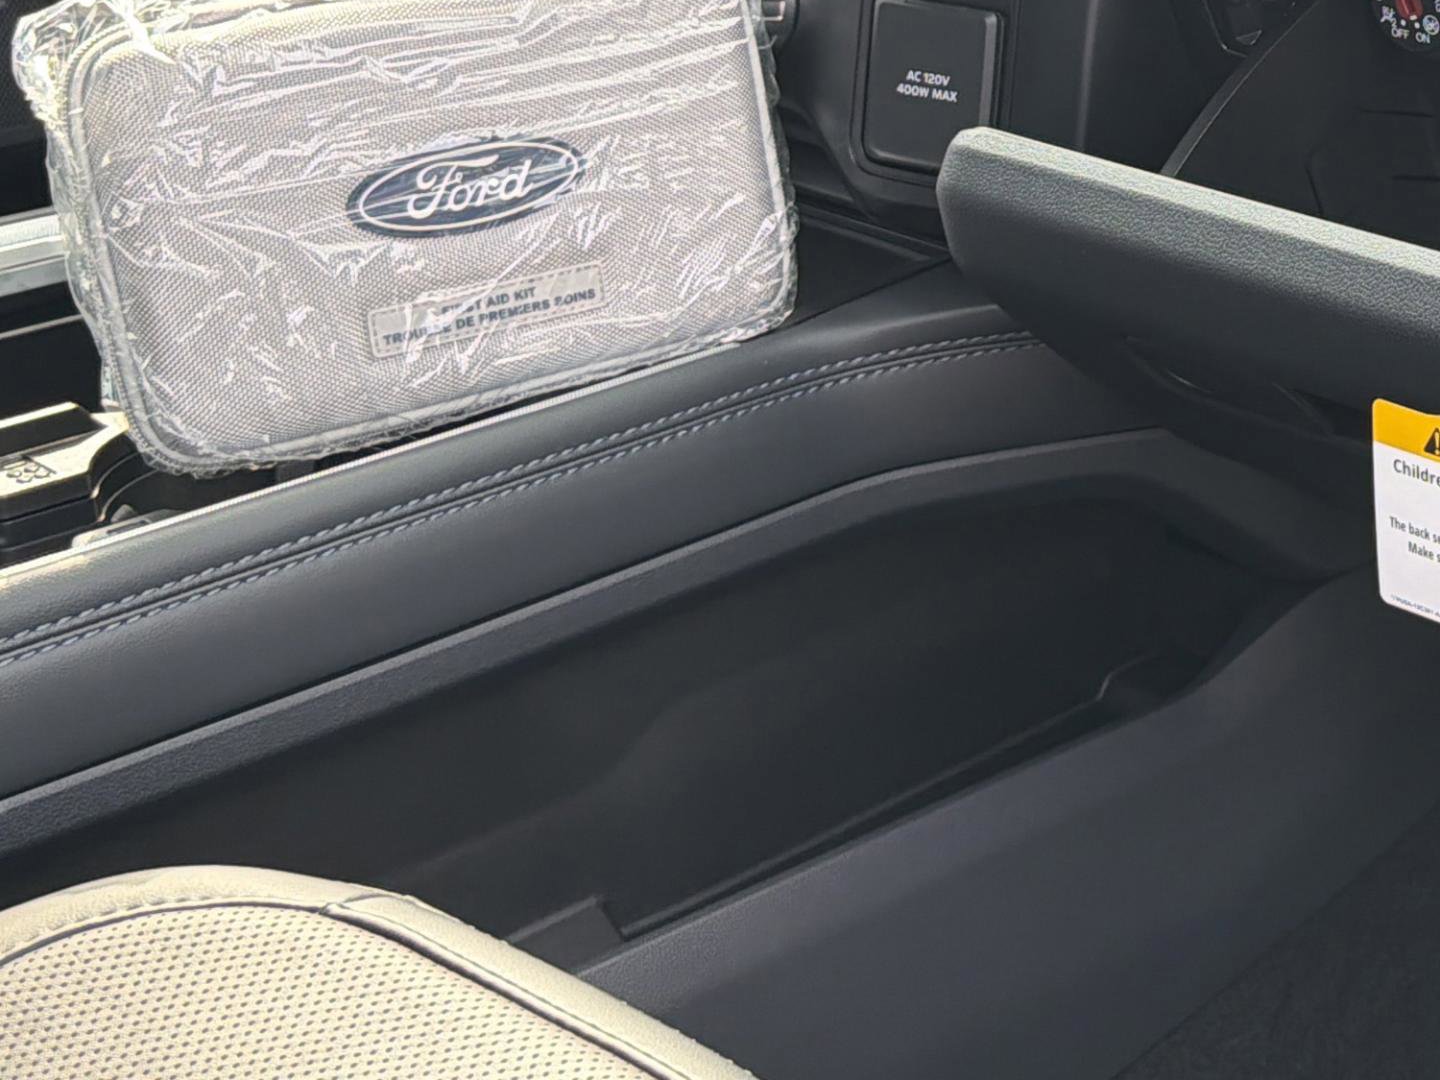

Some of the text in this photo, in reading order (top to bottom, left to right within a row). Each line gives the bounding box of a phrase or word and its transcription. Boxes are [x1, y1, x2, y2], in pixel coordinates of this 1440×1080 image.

[1391, 27, 1410, 39] OFF
[1415, 32, 1431, 44] ON
[906, 70, 951, 87] AC 120V
[896, 83, 958, 103] 400W MAX
[406, 153, 535, 220] Ford
[486, 293, 510, 308] AID
[513, 286, 537, 301] KIT
[456, 317, 475, 330] DE
[1390, 516, 1407, 532] The
[1408, 522, 1431, 541] back
[1408, 541, 1434, 560] Make
